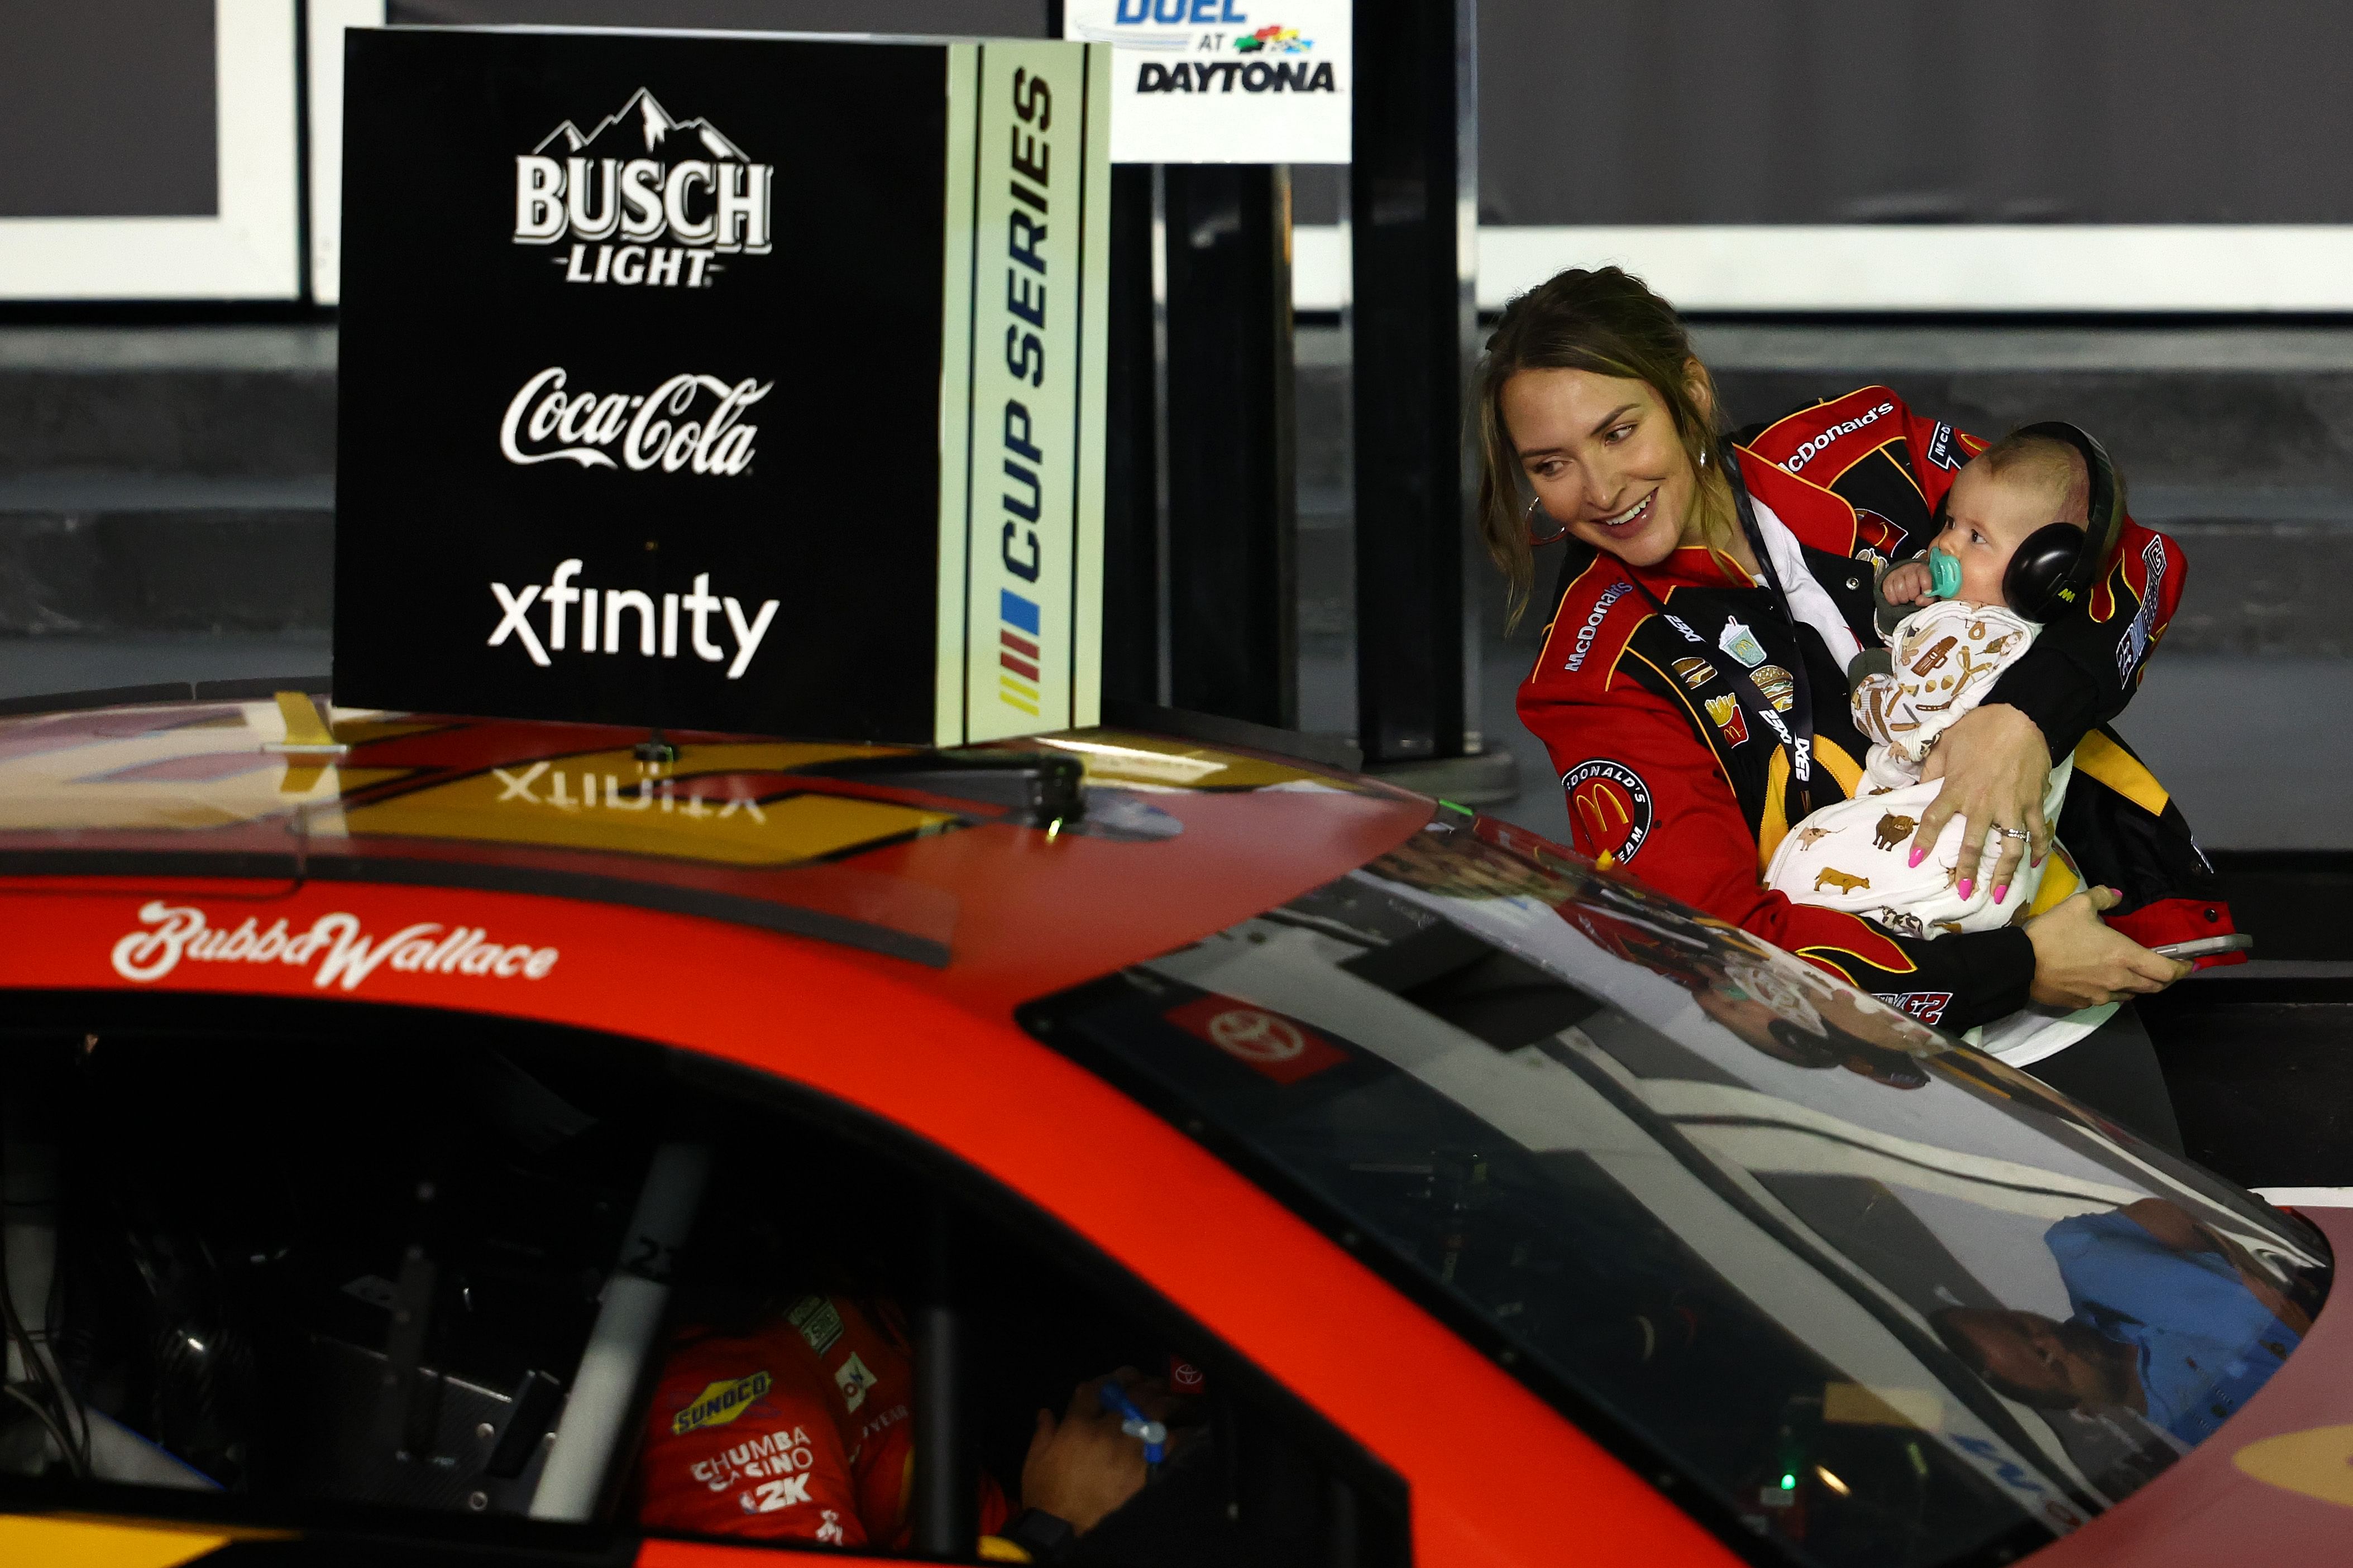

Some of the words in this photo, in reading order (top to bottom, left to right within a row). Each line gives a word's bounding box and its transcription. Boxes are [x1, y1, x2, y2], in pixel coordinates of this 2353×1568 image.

[1197, 33, 1226, 52] AT
[1137, 61, 1335, 93] DAYTONA
[512, 155, 774, 255] BUSCH
[1005, 66, 1053, 389] SERIES
[565, 246, 716, 288] LIGHT
[500, 366, 776, 476] Coca-Cola
[1001, 399, 1043, 584] CUP
[487, 559, 780, 679] xfinity
[1758, 709, 1792, 745] 23XI
[1794, 730, 1810, 782] 23XI
[1567, 765, 1646, 803] DONALD'S
[1613, 826, 1643, 861] EAM
[111, 902, 316, 981] Bubba
[307, 912, 559, 990] Wallace
[677, 1375, 768, 1431] SUNOCO
[691, 1426, 811, 1482] CHUMBA
[755, 1472, 814, 1514] 2K
